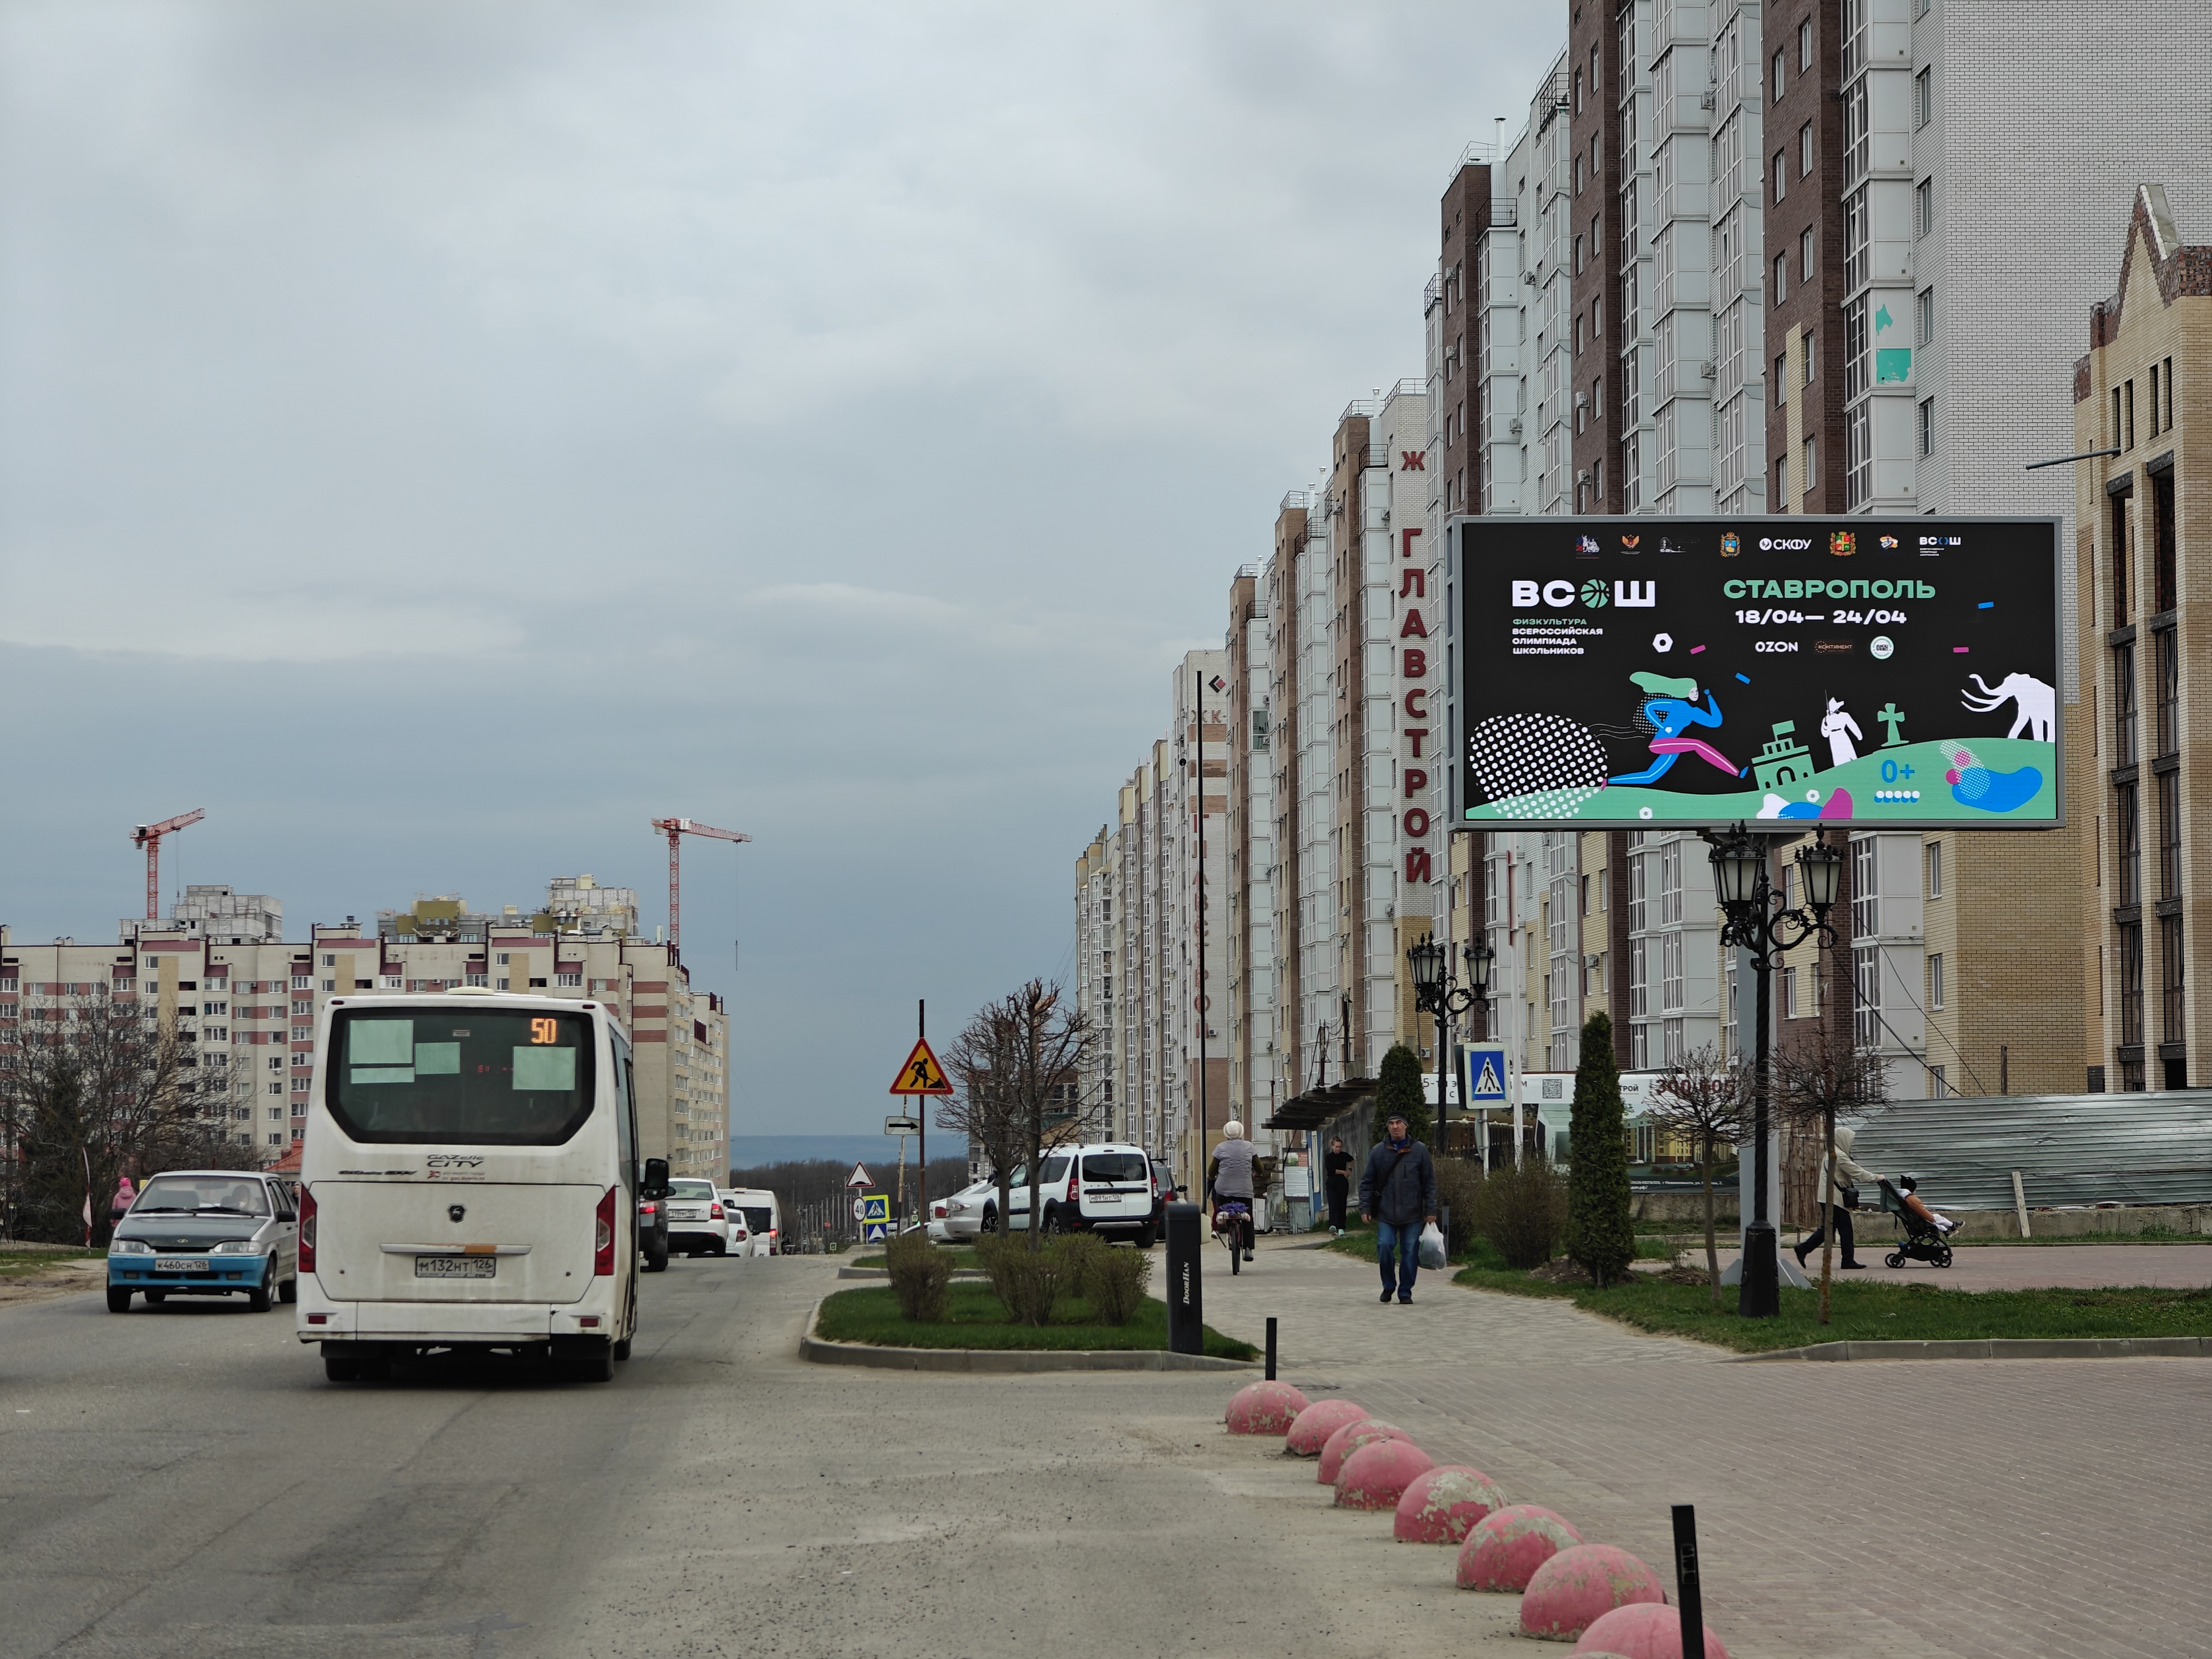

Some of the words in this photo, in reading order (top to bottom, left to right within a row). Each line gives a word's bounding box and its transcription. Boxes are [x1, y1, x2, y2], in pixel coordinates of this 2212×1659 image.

[1773, 538, 1812, 551] СКФУ
[1723, 579, 1936, 599] СТАВРОПОЛЬ
[1833, 609, 1907, 625] 24/04
[1512, 626, 1603, 635] ВСЕРОССИЙСКАЯ
[1512, 637, 1577, 646] ОЛИМПИАДА
[1755, 641, 1798, 652] OZON
[1399, 528, 1431, 882] ГЛАВСТРОЙ
[1882, 759, 1915, 783] 0+
[531, 1017, 557, 1044] 50
[855, 1204, 864, 1214] 40
[472, 1259, 493, 1269] 126
